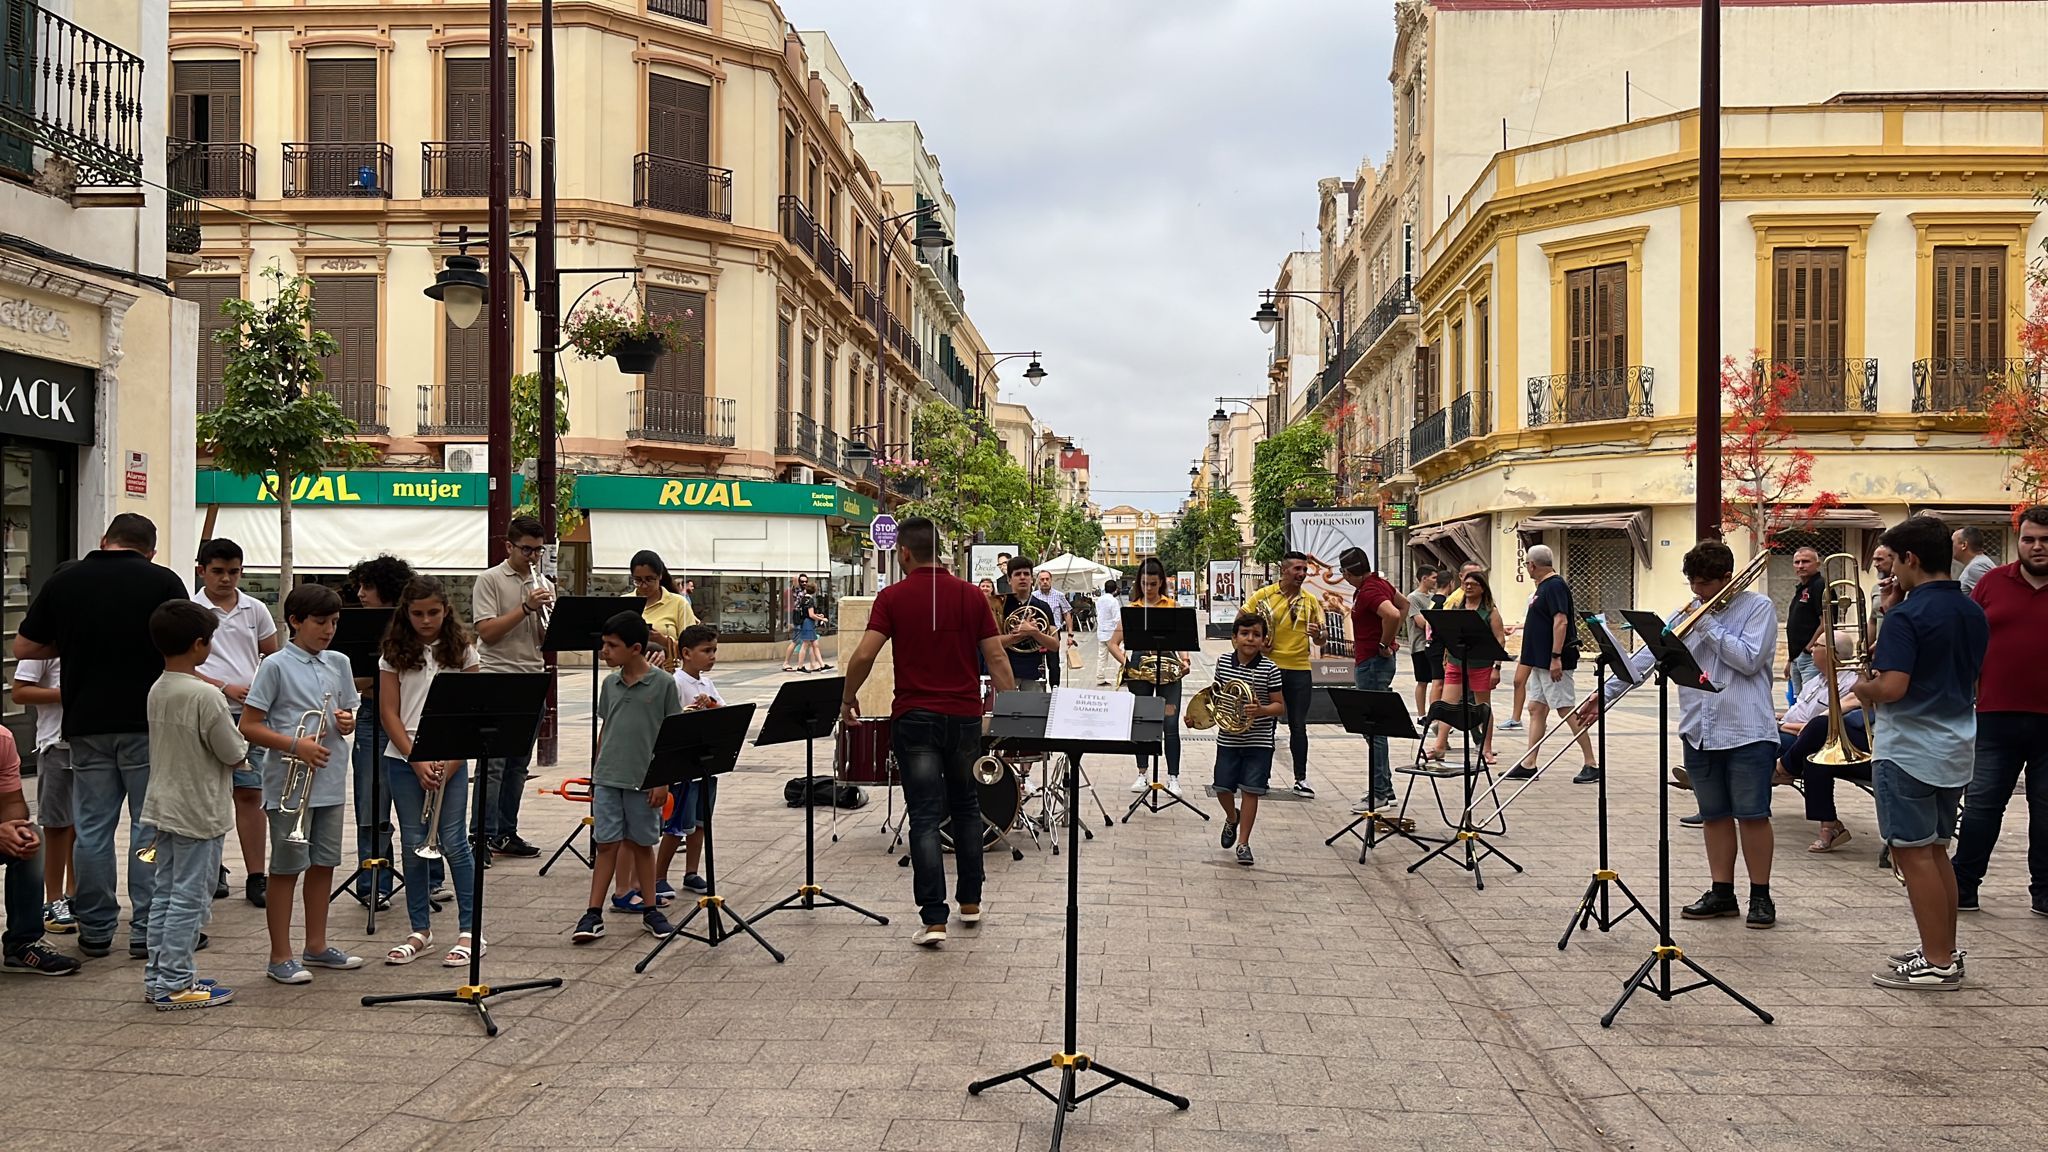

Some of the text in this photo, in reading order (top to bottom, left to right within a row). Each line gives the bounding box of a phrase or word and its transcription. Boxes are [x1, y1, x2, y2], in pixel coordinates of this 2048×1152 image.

[0, 376, 76, 423] ACK
[392, 479, 462, 501] mujer
[658, 480, 753, 507] RUAL
[875, 524, 896, 532] STOP
[1301, 518, 1365, 526] MODERNISMO
[1216, 571, 1235, 584] ASÍ
